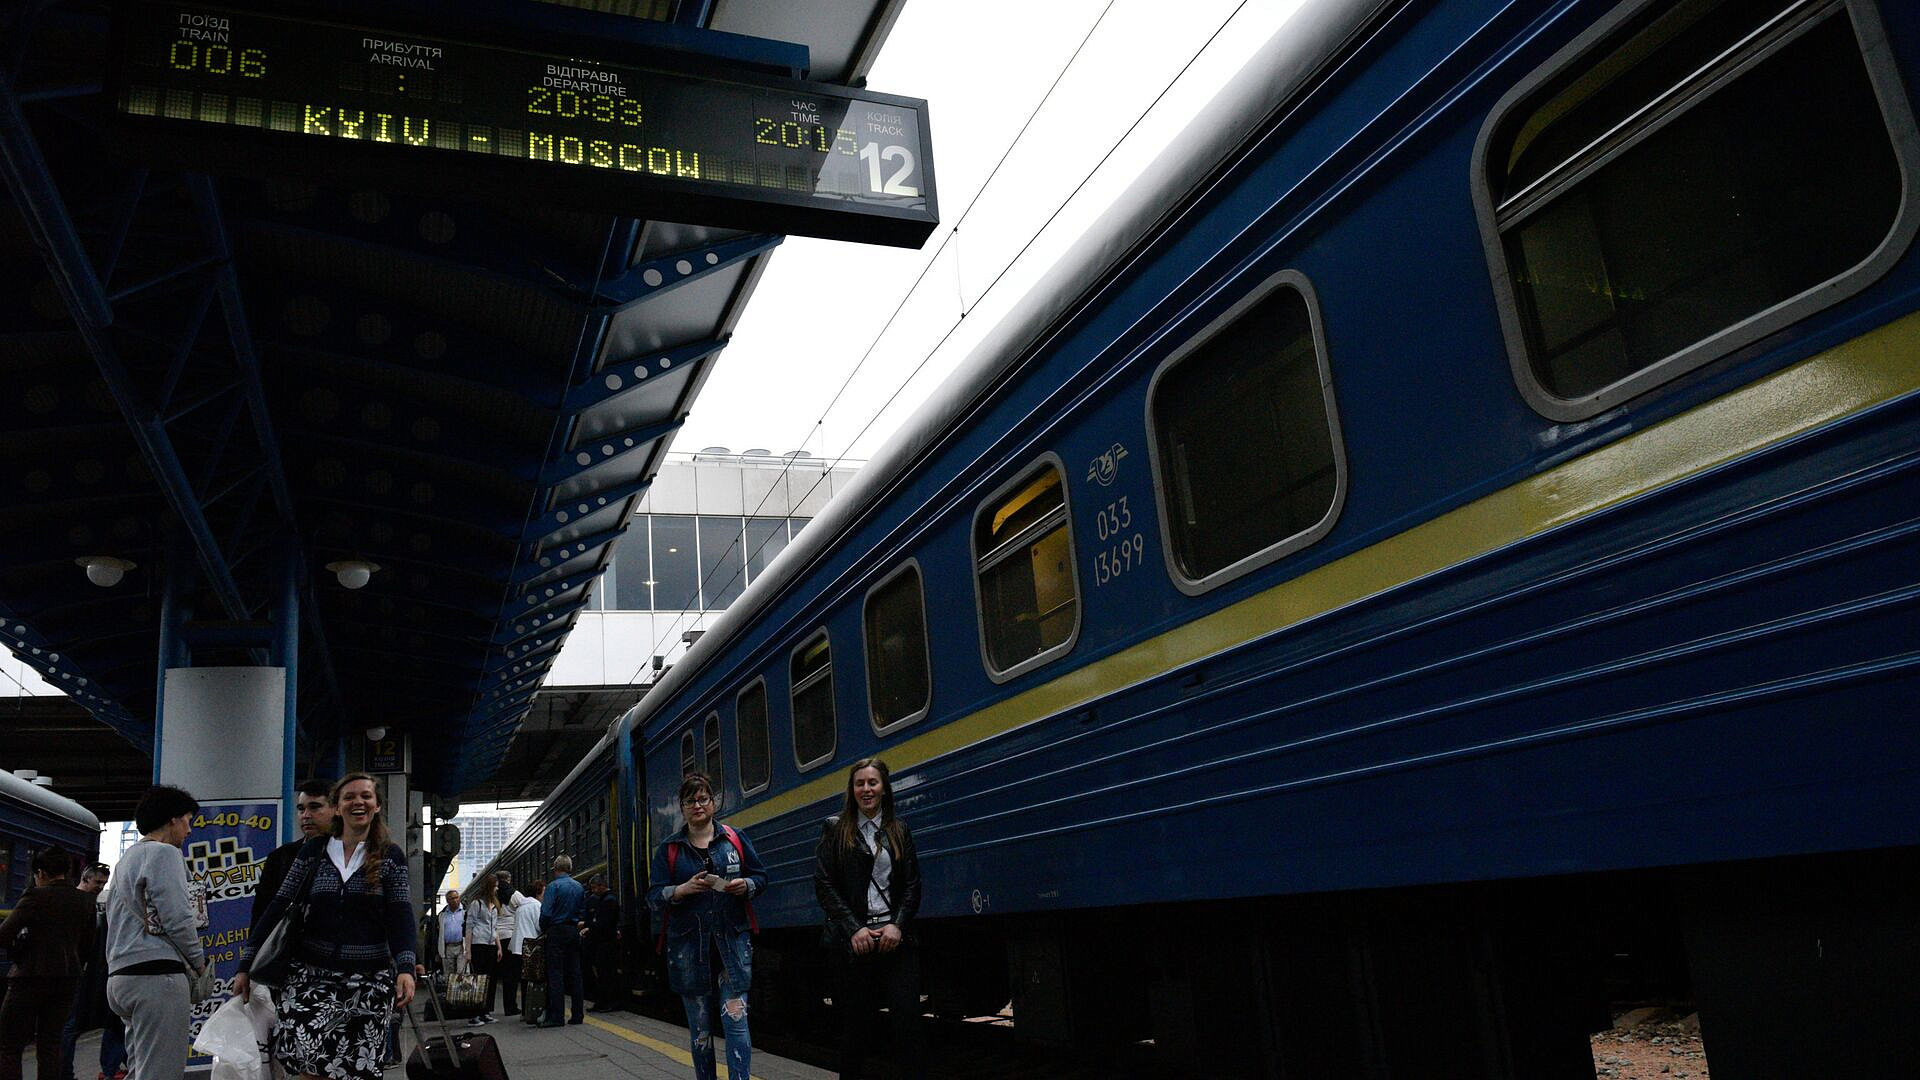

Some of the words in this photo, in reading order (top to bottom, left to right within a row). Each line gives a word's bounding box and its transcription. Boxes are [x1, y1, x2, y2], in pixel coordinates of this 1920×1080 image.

[179, 12, 230, 32] ПОЇЗД
[179, 26, 230, 43] TRAIN
[362, 37, 443, 58] ПРИБУТТЯ
[170, 40, 268, 78] 006
[370, 52, 436, 71] ARRIVAL
[546, 63, 623, 84] ВІДПРАВЛ.
[543, 75, 628, 98] DEPARTURE
[527, 86, 642, 127] 20:33
[790, 99, 818, 113] ЧАС
[790, 111, 822, 125] TIME
[866, 110, 902, 126] КОЛІЯ
[755, 117, 859, 157] 20:15
[866, 122, 904, 137] TRACK
[303, 104, 430, 146] KYIV
[529, 131, 700, 180] MOSCOW
[859, 141, 919, 198] 12
[1096, 495, 1131, 541] 033
[1094, 532, 1143, 587] 13699
